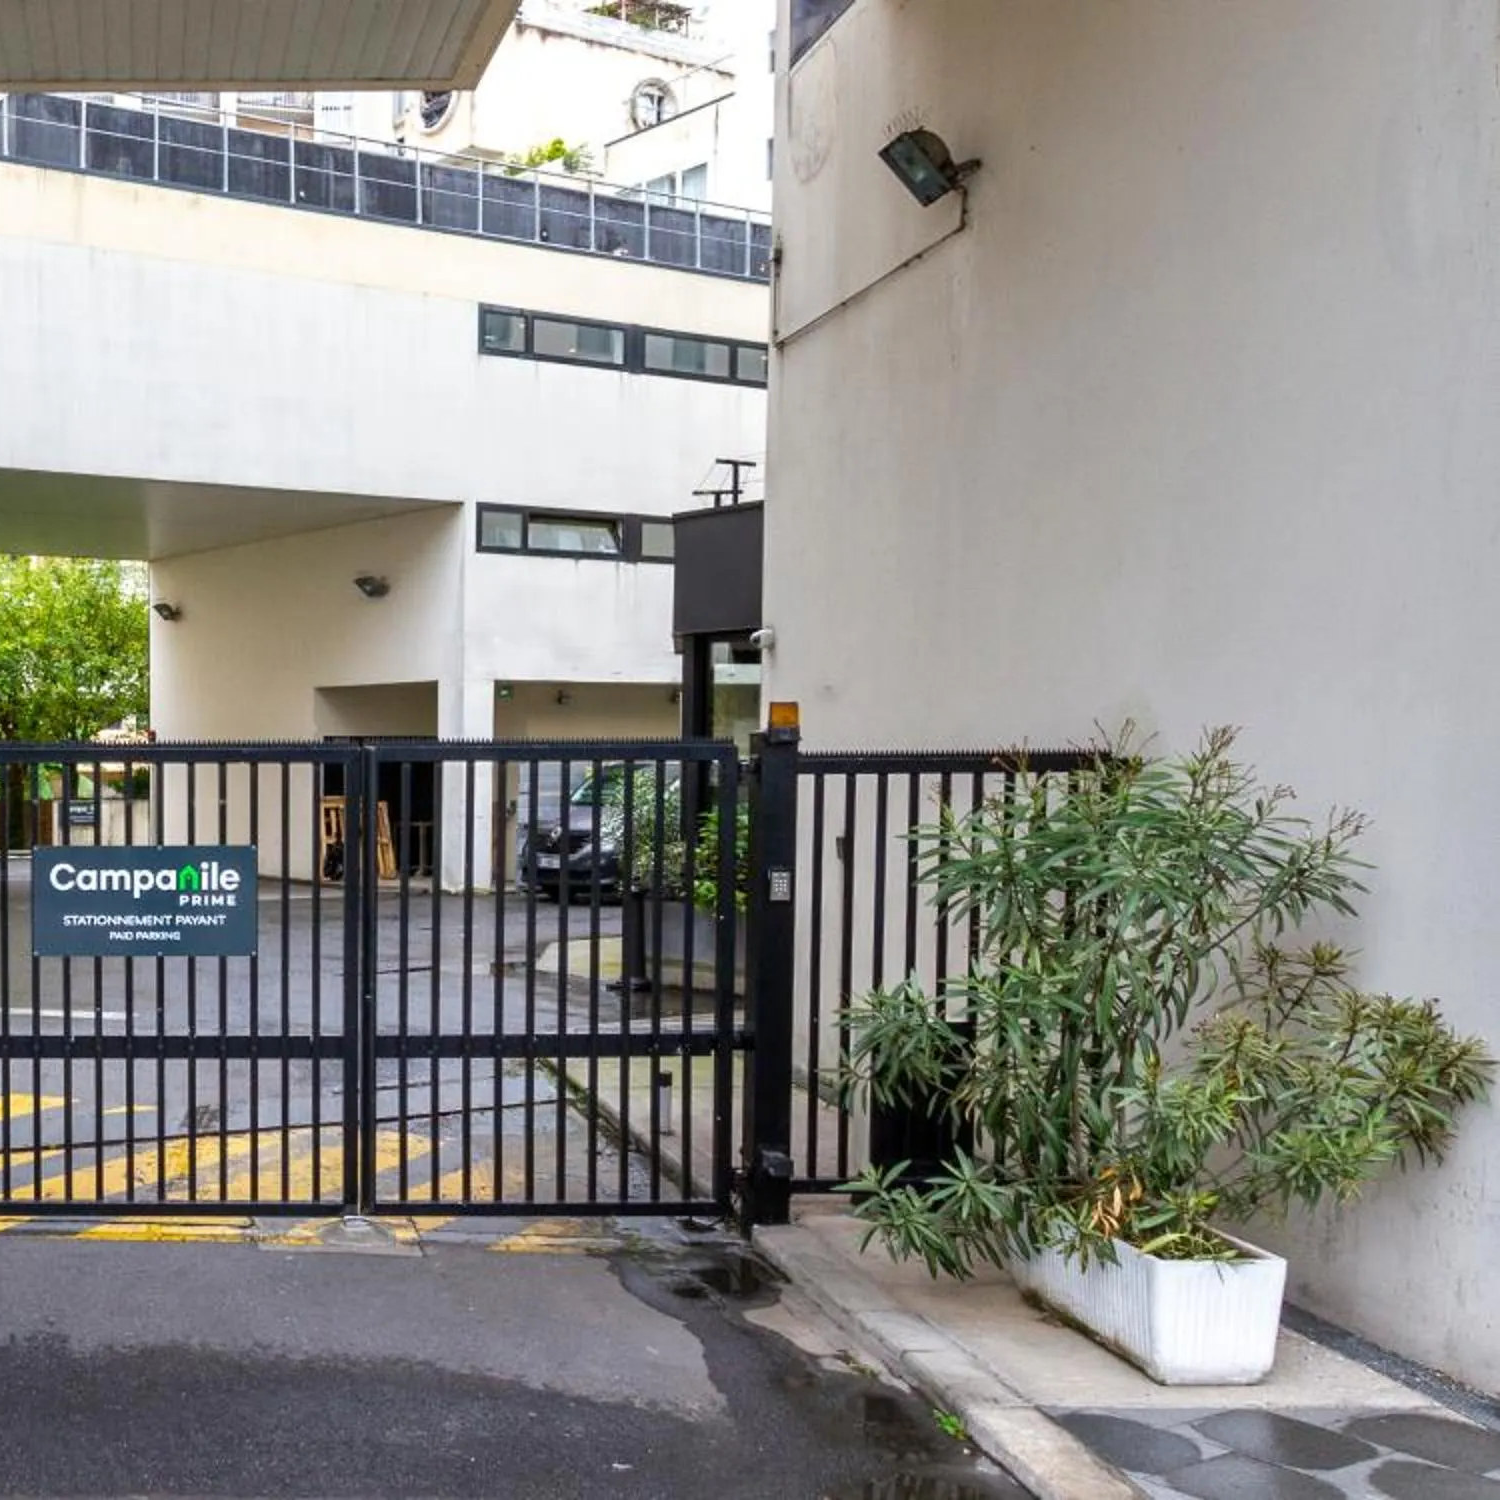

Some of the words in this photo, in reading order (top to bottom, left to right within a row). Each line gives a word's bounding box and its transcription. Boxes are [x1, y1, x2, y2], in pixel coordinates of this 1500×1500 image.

[50, 862, 240, 898] Campanile
[179, 895, 236, 906] PRIME
[63, 915, 171, 926] STATIONNEMENT
[175, 915, 226, 926] PAYANT
[109, 931, 133, 941] PAID
[136, 931, 181, 941] PARKING
